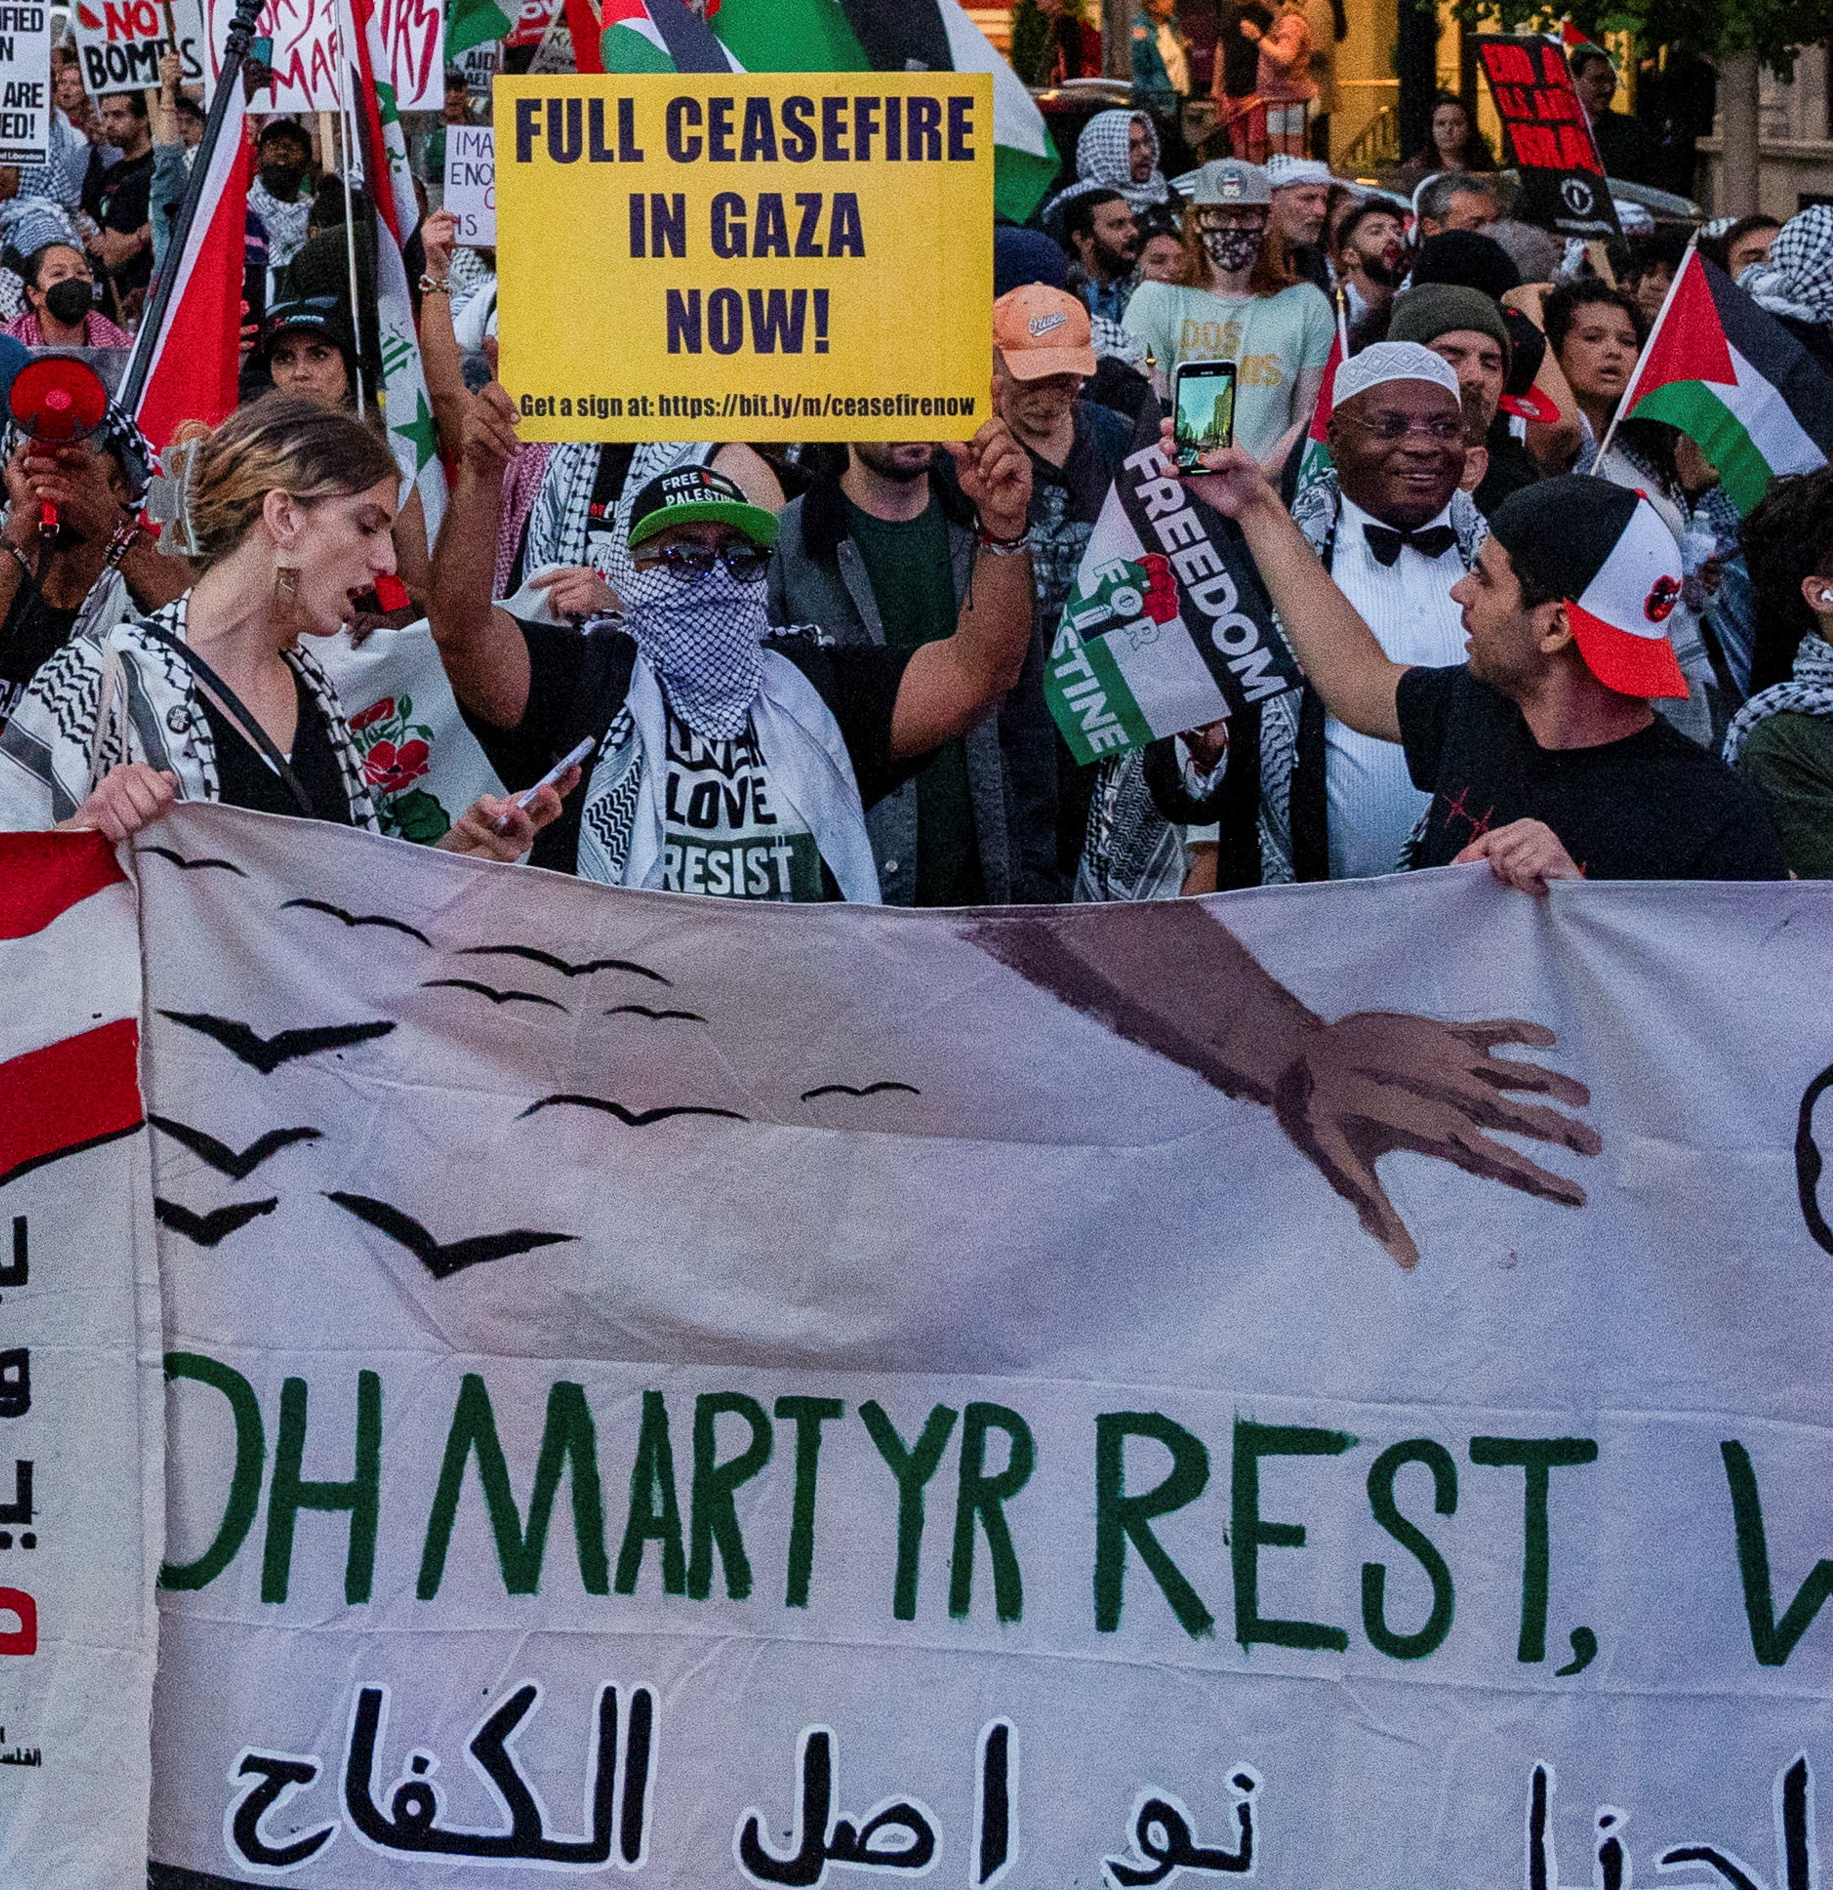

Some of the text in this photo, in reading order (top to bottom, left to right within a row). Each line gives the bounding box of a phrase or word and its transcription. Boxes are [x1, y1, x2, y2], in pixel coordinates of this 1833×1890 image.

[464, 51, 495, 68] AID
[2, 82, 44, 109] ARE
[515, 96, 975, 163] FULL CEASEFIRE
[629, 191, 866, 259] IN GAZA
[666, 287, 830, 355] NOW!
[1181, 319, 1242, 353] DOS
[520, 393, 976, 420] Get a sign at: https://bit.ly/m/ceasefirenow
[662, 473, 701, 493] FREE
[1123, 444, 1287, 703] FREEDOM
[664, 771, 777, 829] LOVE
[661, 843, 794, 896] RESIST
[417, 1372, 1035, 1624] MARTYR
[1092, 1410, 1600, 1678] REST,
[229, 1683, 656, 1867] الكفاح
